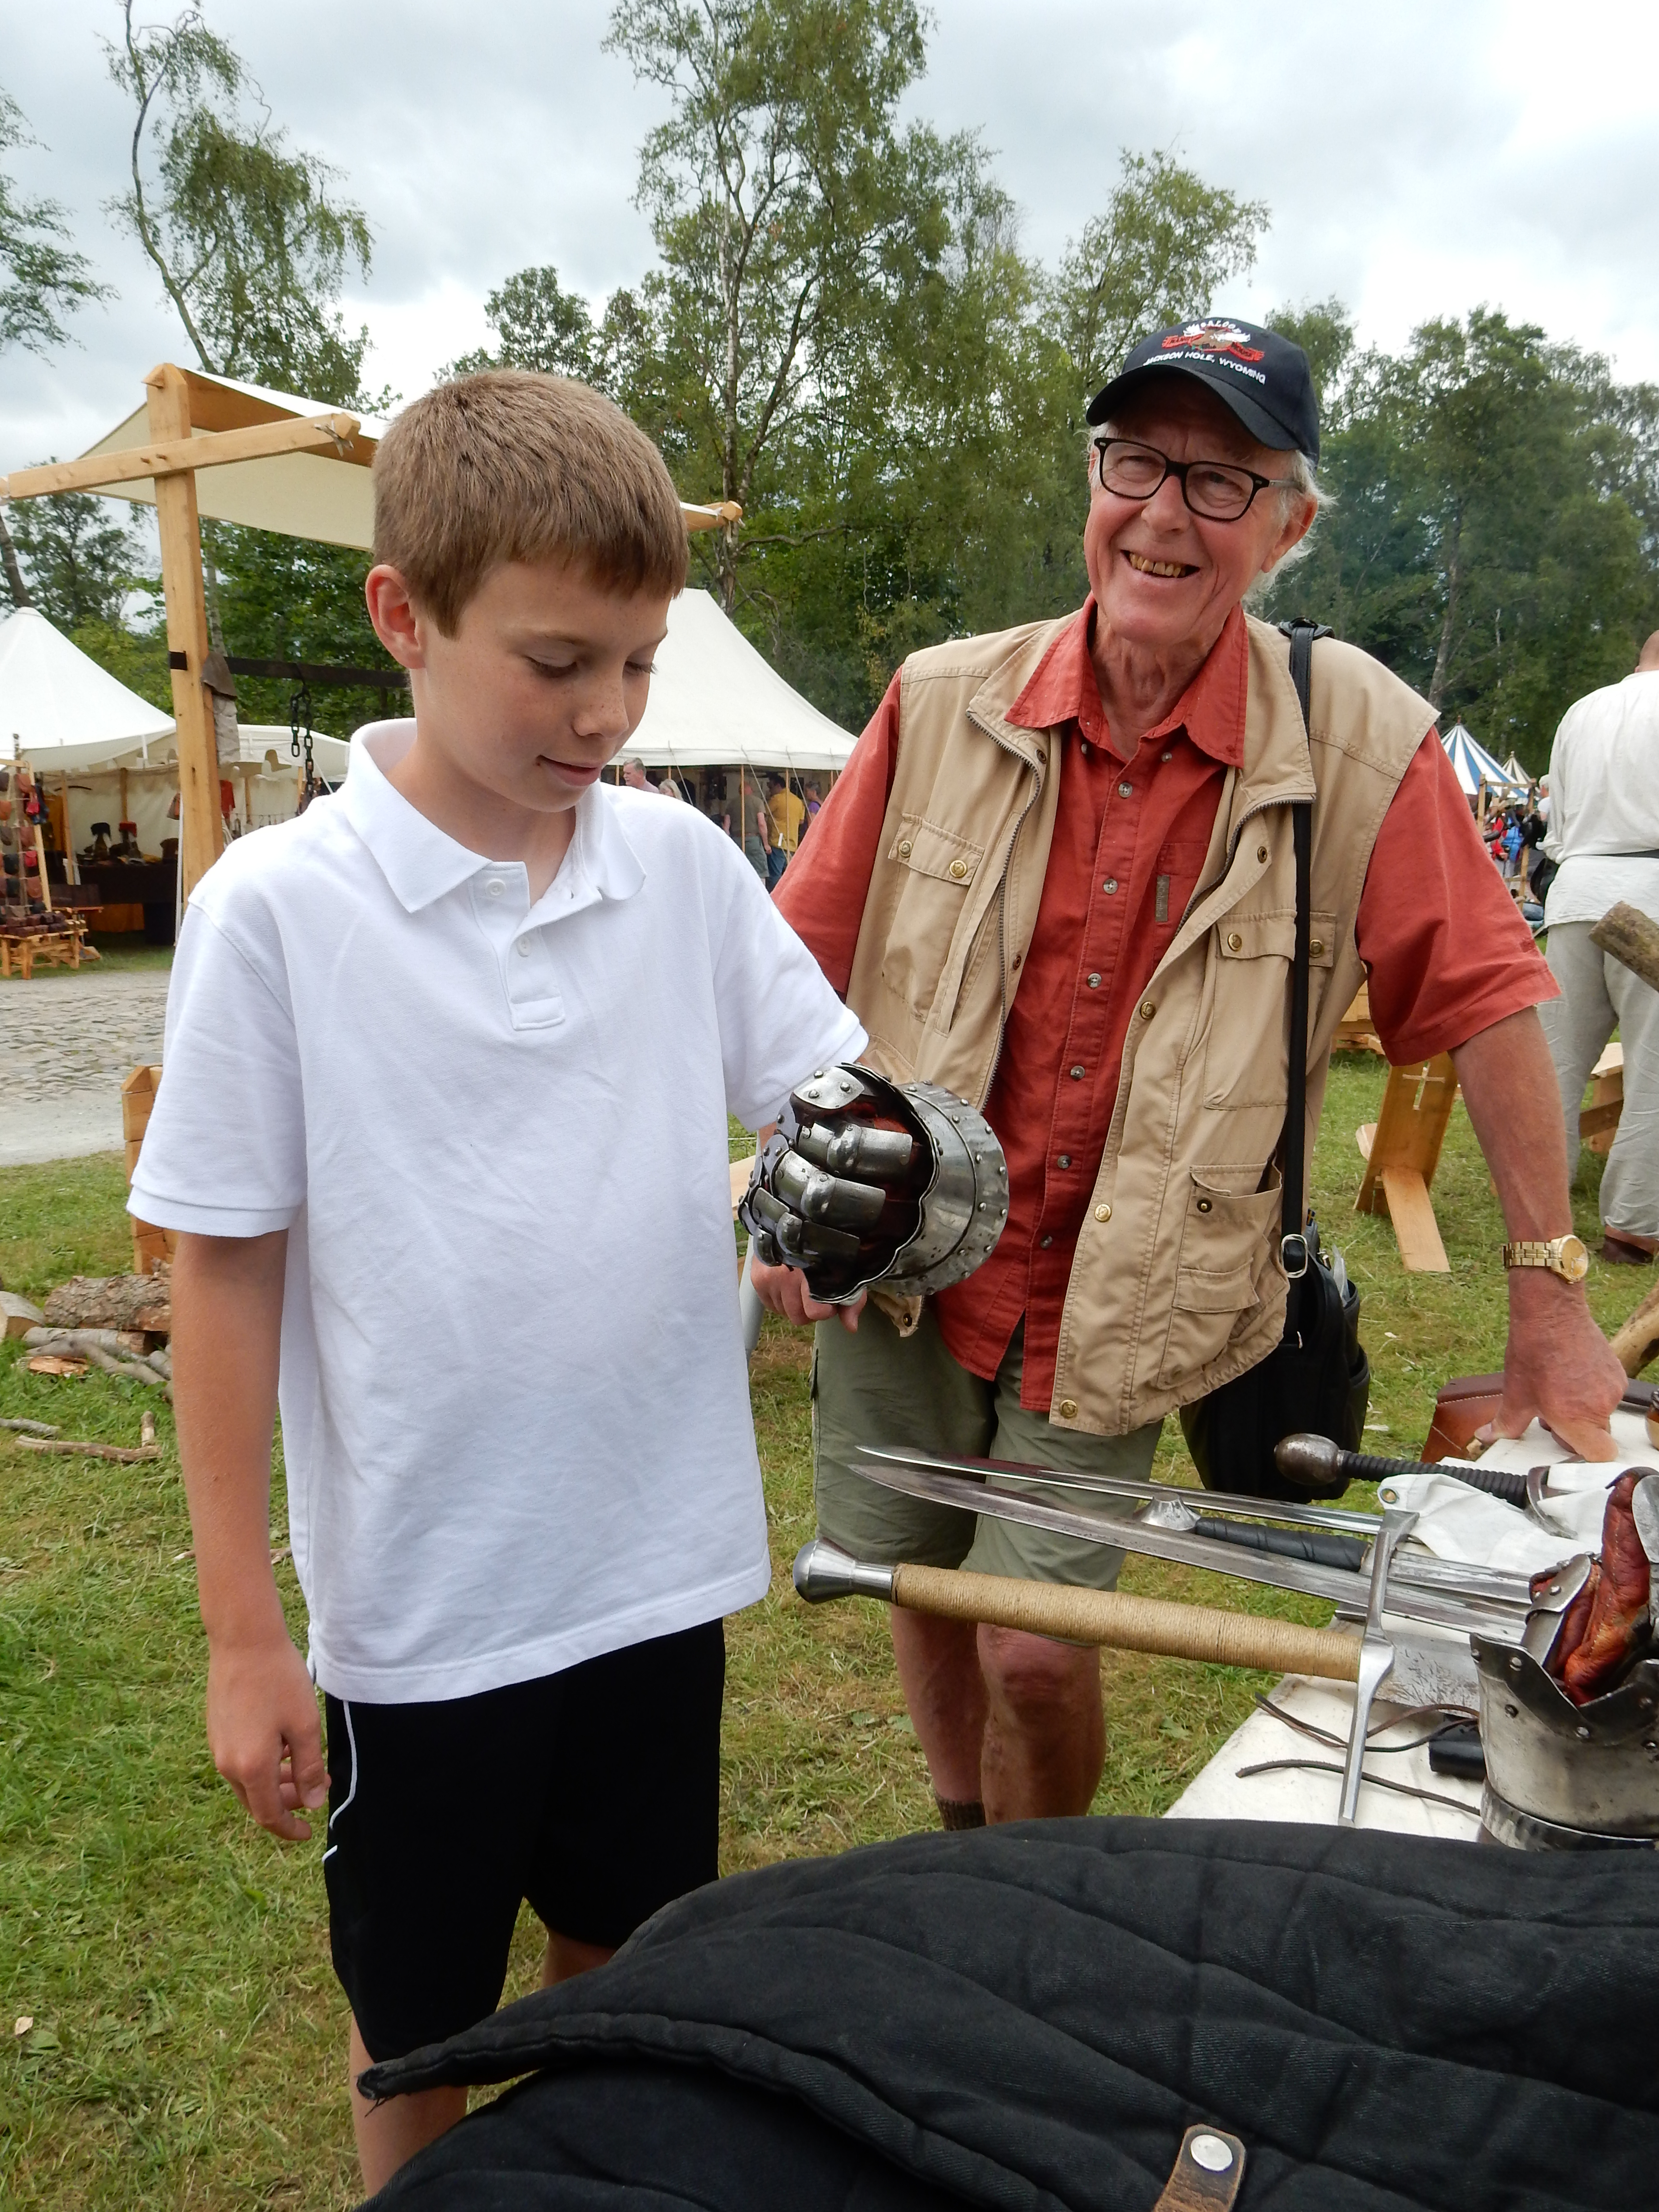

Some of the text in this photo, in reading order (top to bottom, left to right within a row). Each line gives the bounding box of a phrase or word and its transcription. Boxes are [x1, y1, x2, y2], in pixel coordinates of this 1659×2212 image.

[1143, 351, 1266, 385] JACKSON HOLE, WYOMING
[1155, 887, 1166, 917] Columbia
